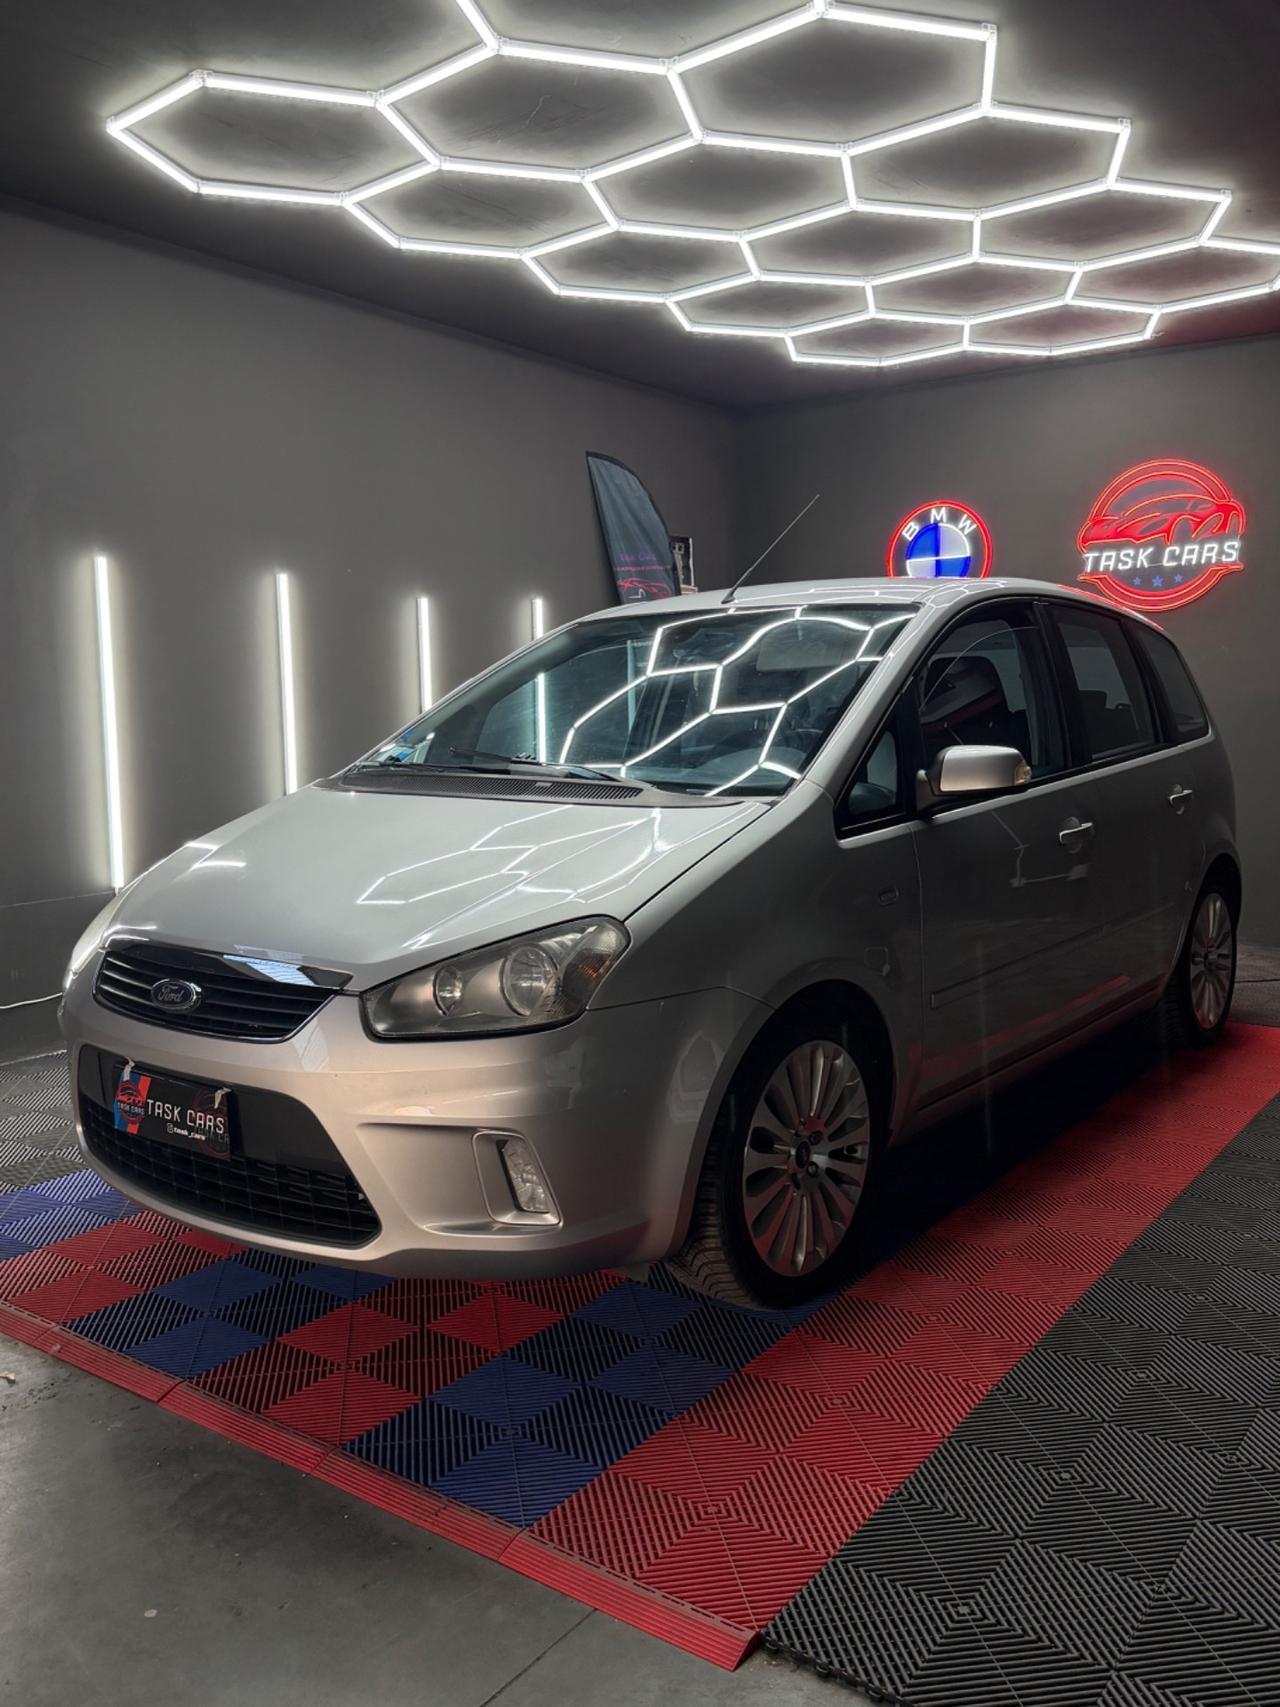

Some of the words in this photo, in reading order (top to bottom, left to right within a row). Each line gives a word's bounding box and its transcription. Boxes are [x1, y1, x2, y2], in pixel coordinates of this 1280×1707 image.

[902, 507, 977, 541] BMW
[1084, 547, 1154, 572] TASK
[1162, 541, 1239, 566] CARS
[158, 978, 184, 1001] Ford
[147, 1099, 181, 1122] TASK
[186, 1110, 225, 1134] CARS
